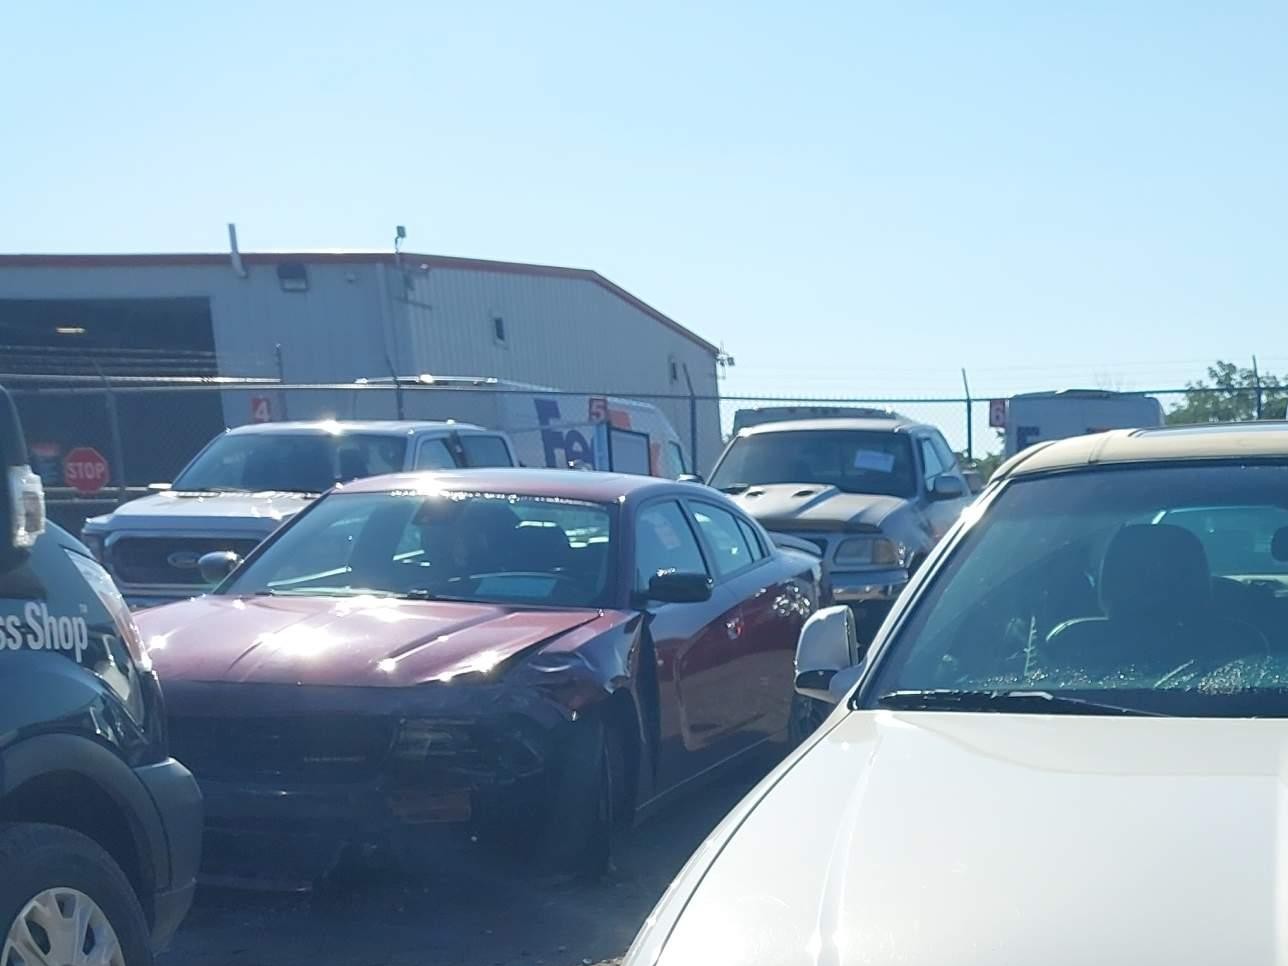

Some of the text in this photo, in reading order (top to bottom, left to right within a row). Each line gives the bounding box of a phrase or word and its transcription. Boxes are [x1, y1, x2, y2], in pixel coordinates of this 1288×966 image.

[255, 401, 270, 421] 4
[592, 402, 607, 422] 5
[991, 404, 1004, 426] 6
[66, 461, 106, 480] STOP
[24, 601, 88, 663] Shop
